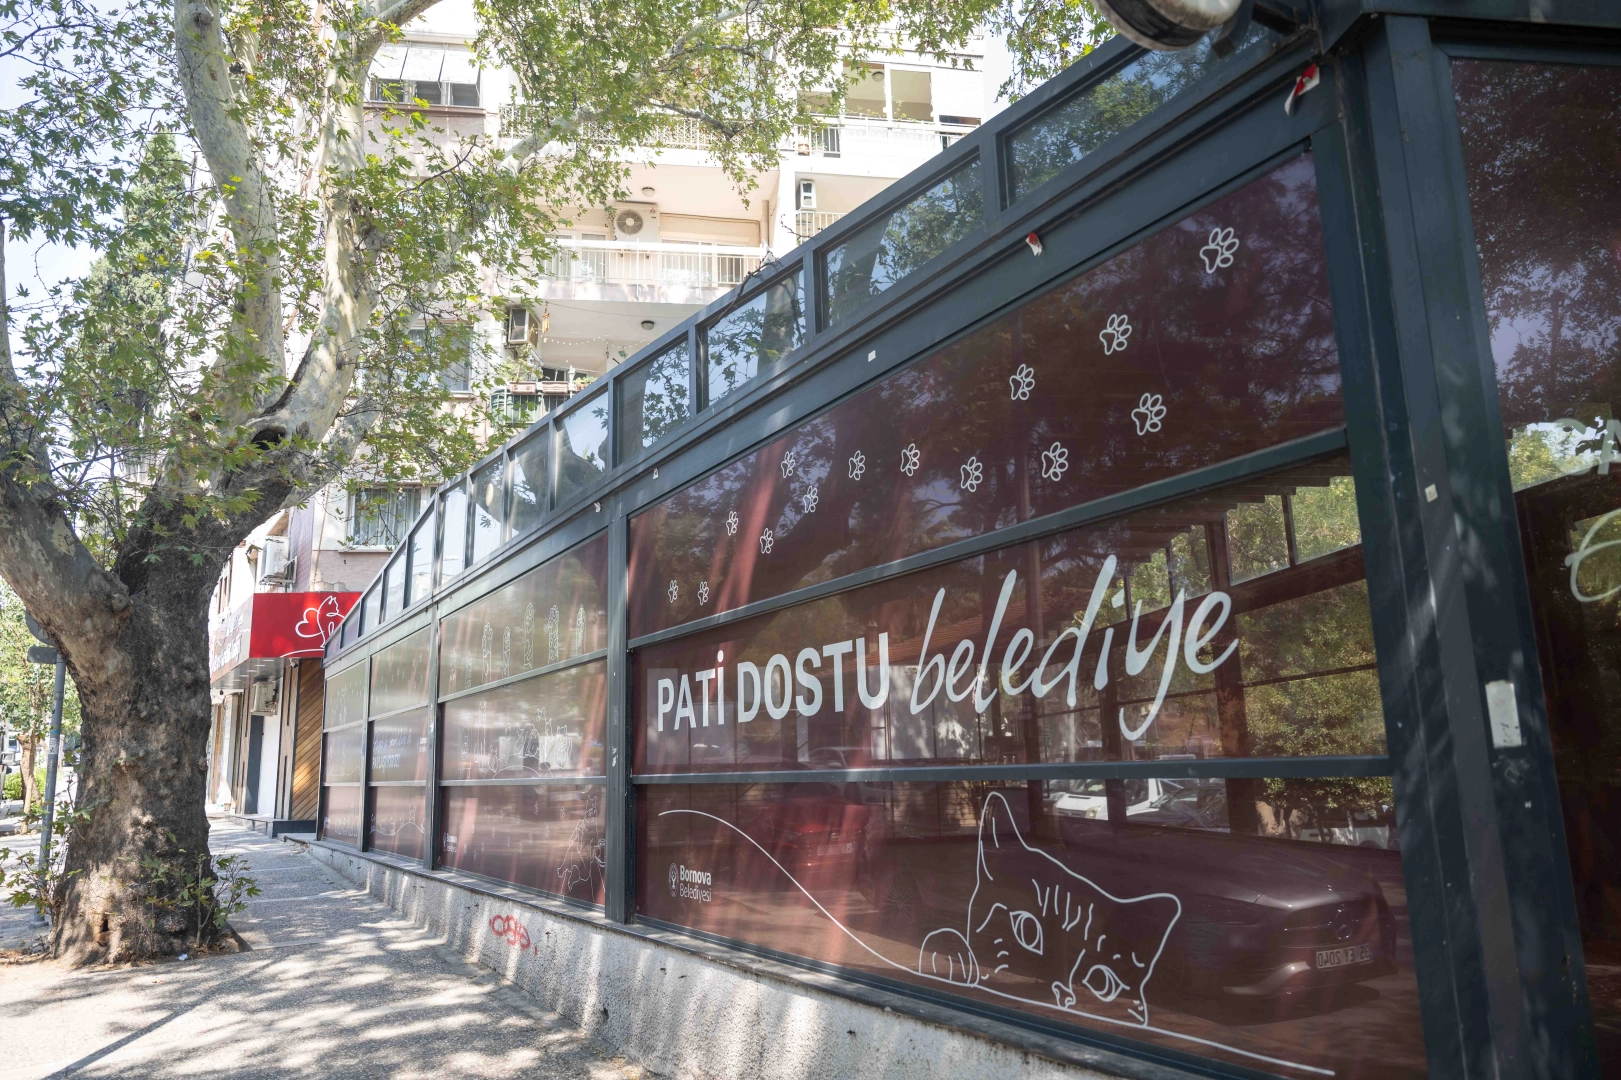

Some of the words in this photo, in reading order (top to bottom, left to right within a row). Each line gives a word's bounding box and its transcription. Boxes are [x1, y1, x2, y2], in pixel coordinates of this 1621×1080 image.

[737, 632, 890, 723] DOSTU
[910, 554, 1239, 741] belediye
[680, 864, 712, 886] Bornova
[680, 883, 712, 904] Belediyesi
